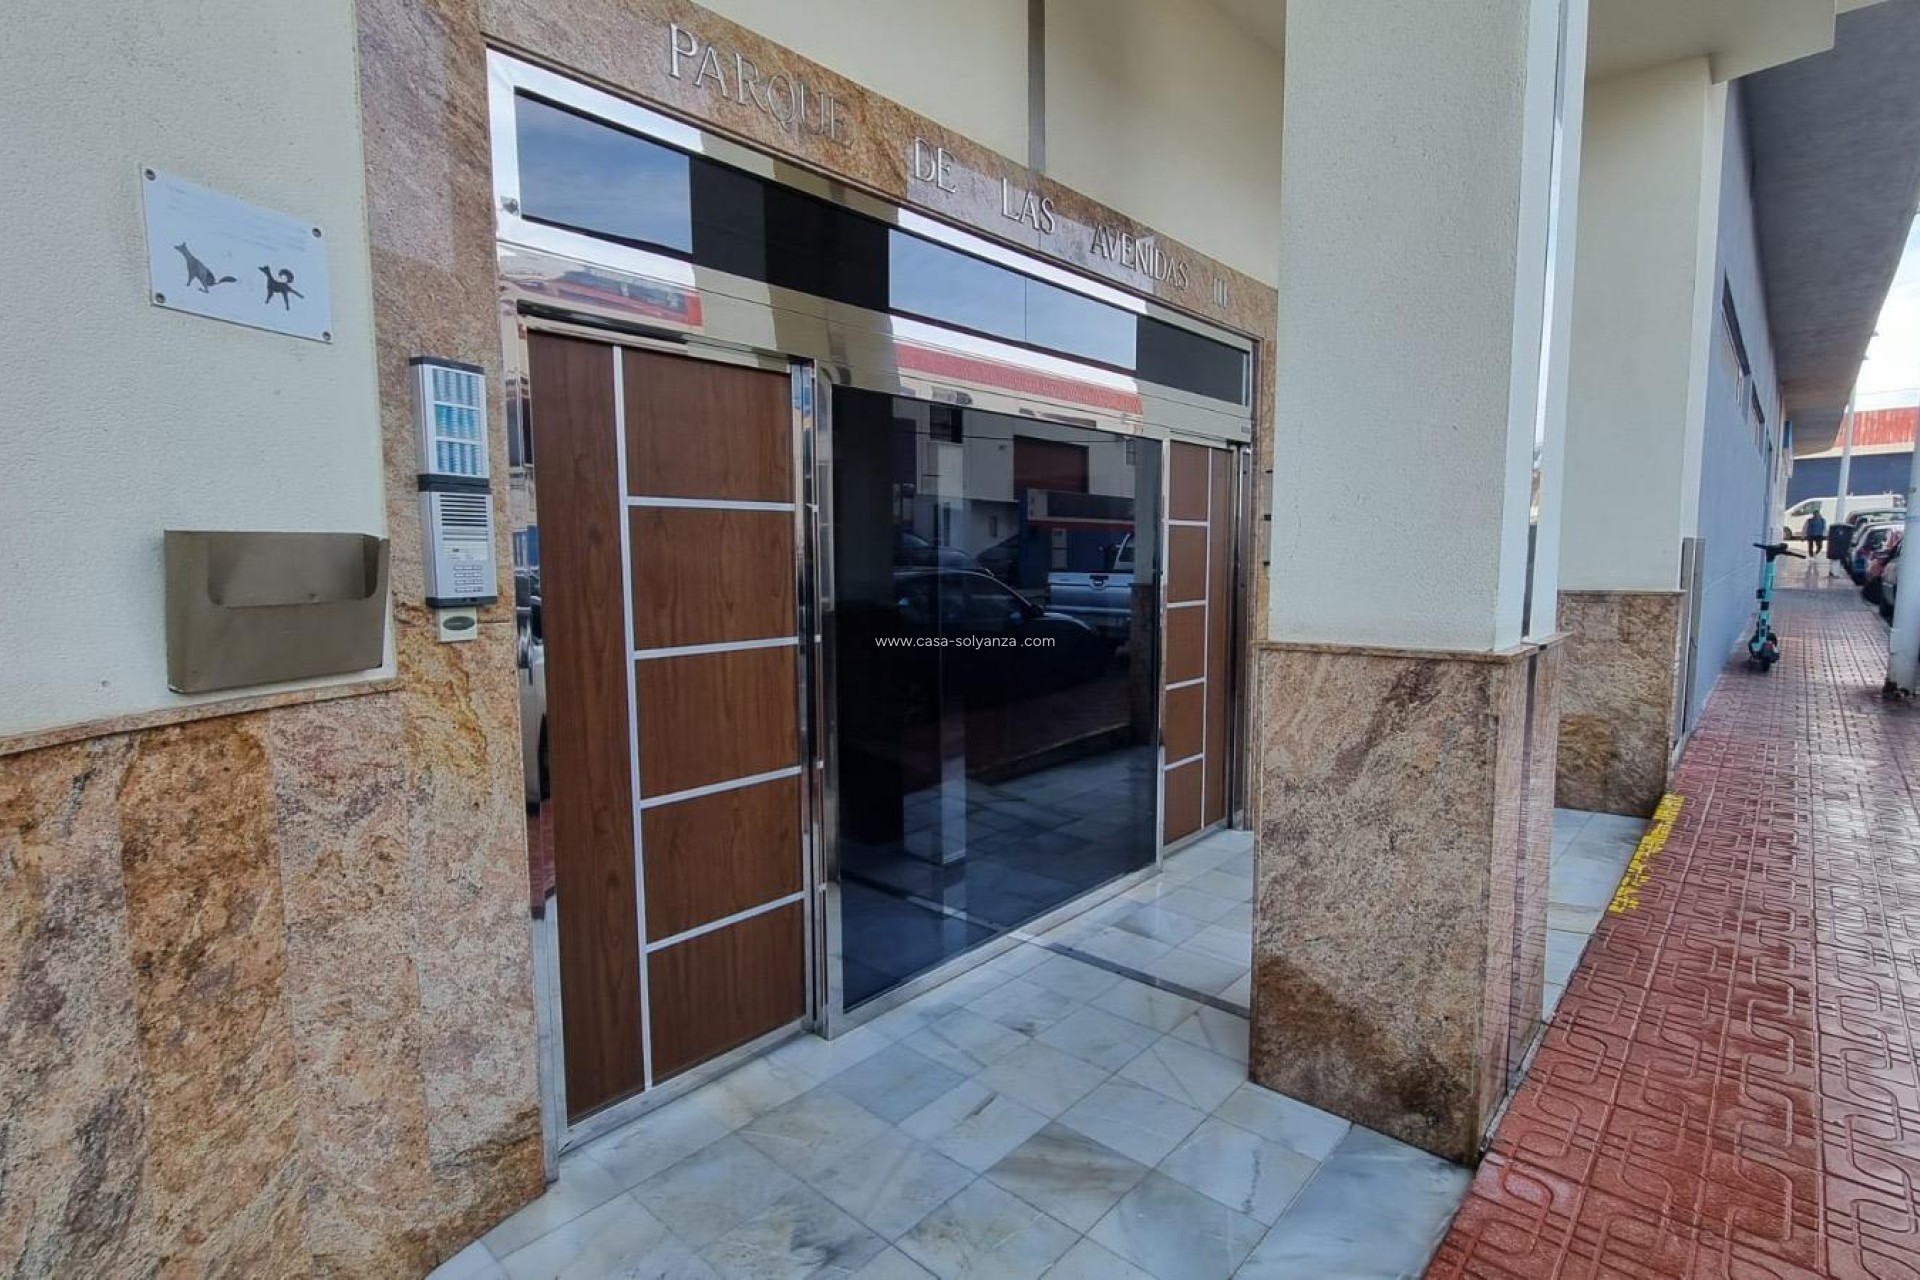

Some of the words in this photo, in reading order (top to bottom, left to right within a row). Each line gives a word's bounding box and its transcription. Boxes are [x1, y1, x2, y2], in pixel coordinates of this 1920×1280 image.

[667, 24, 854, 149] PARQUE
[912, 136, 957, 194] DE
[1000, 177, 1056, 235] LAS
[1090, 223, 1189, 290] AVENIDAS
